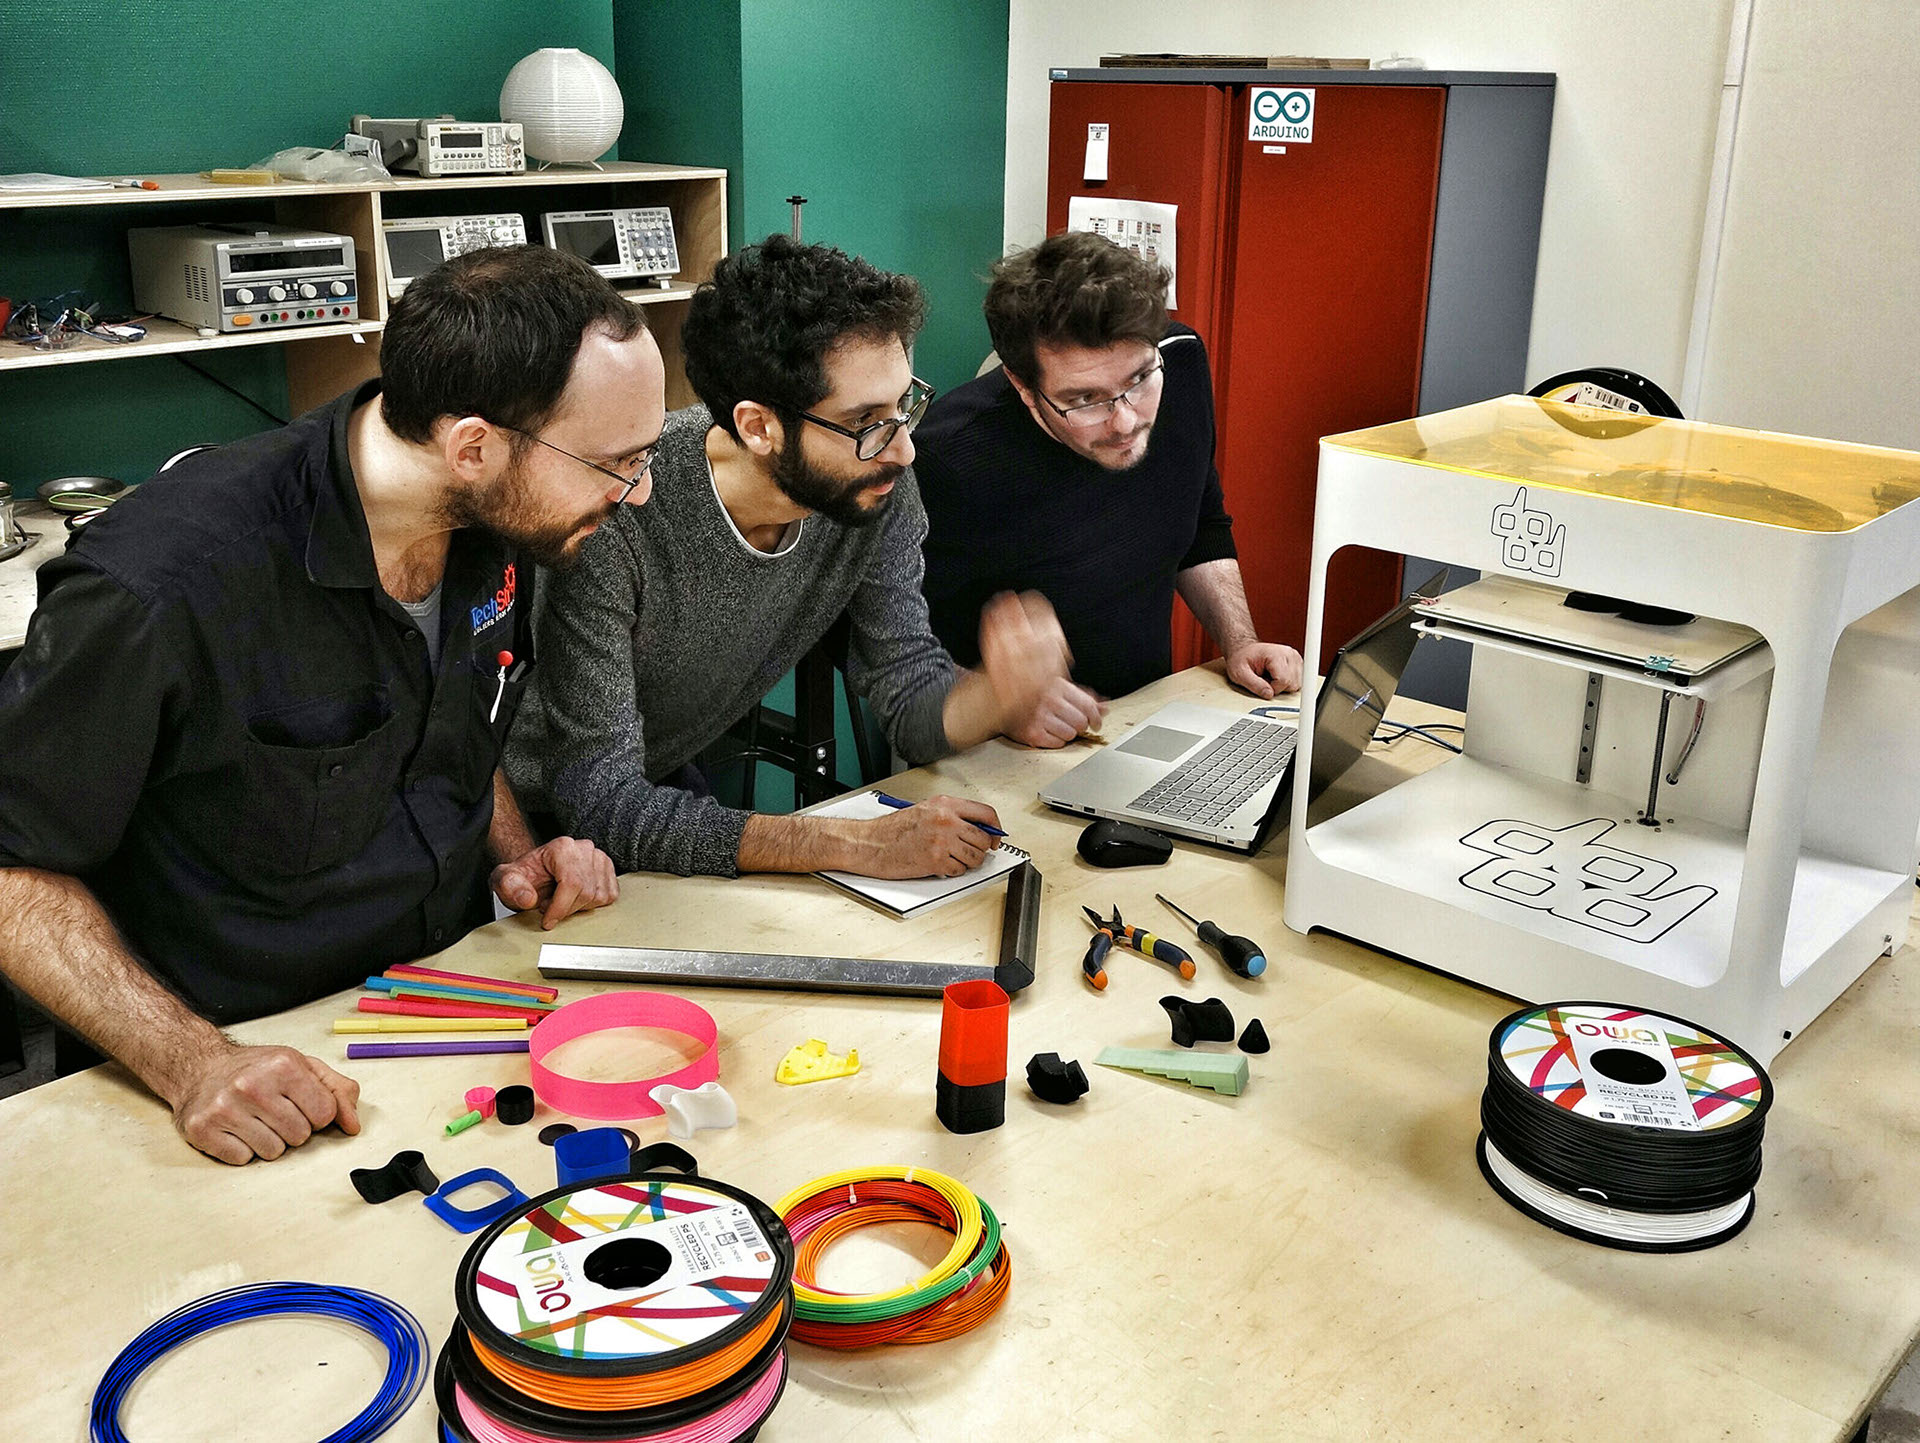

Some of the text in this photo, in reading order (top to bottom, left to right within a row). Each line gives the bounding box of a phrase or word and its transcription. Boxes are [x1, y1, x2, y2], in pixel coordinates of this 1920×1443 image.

[1252, 125, 1309, 139] ARDUINO
[1599, 1089, 1658, 1099] RECYCLED
[669, 1227, 697, 1274] PREMIUM QUALITY
[680, 1223, 711, 1271] RECYCLED PS
